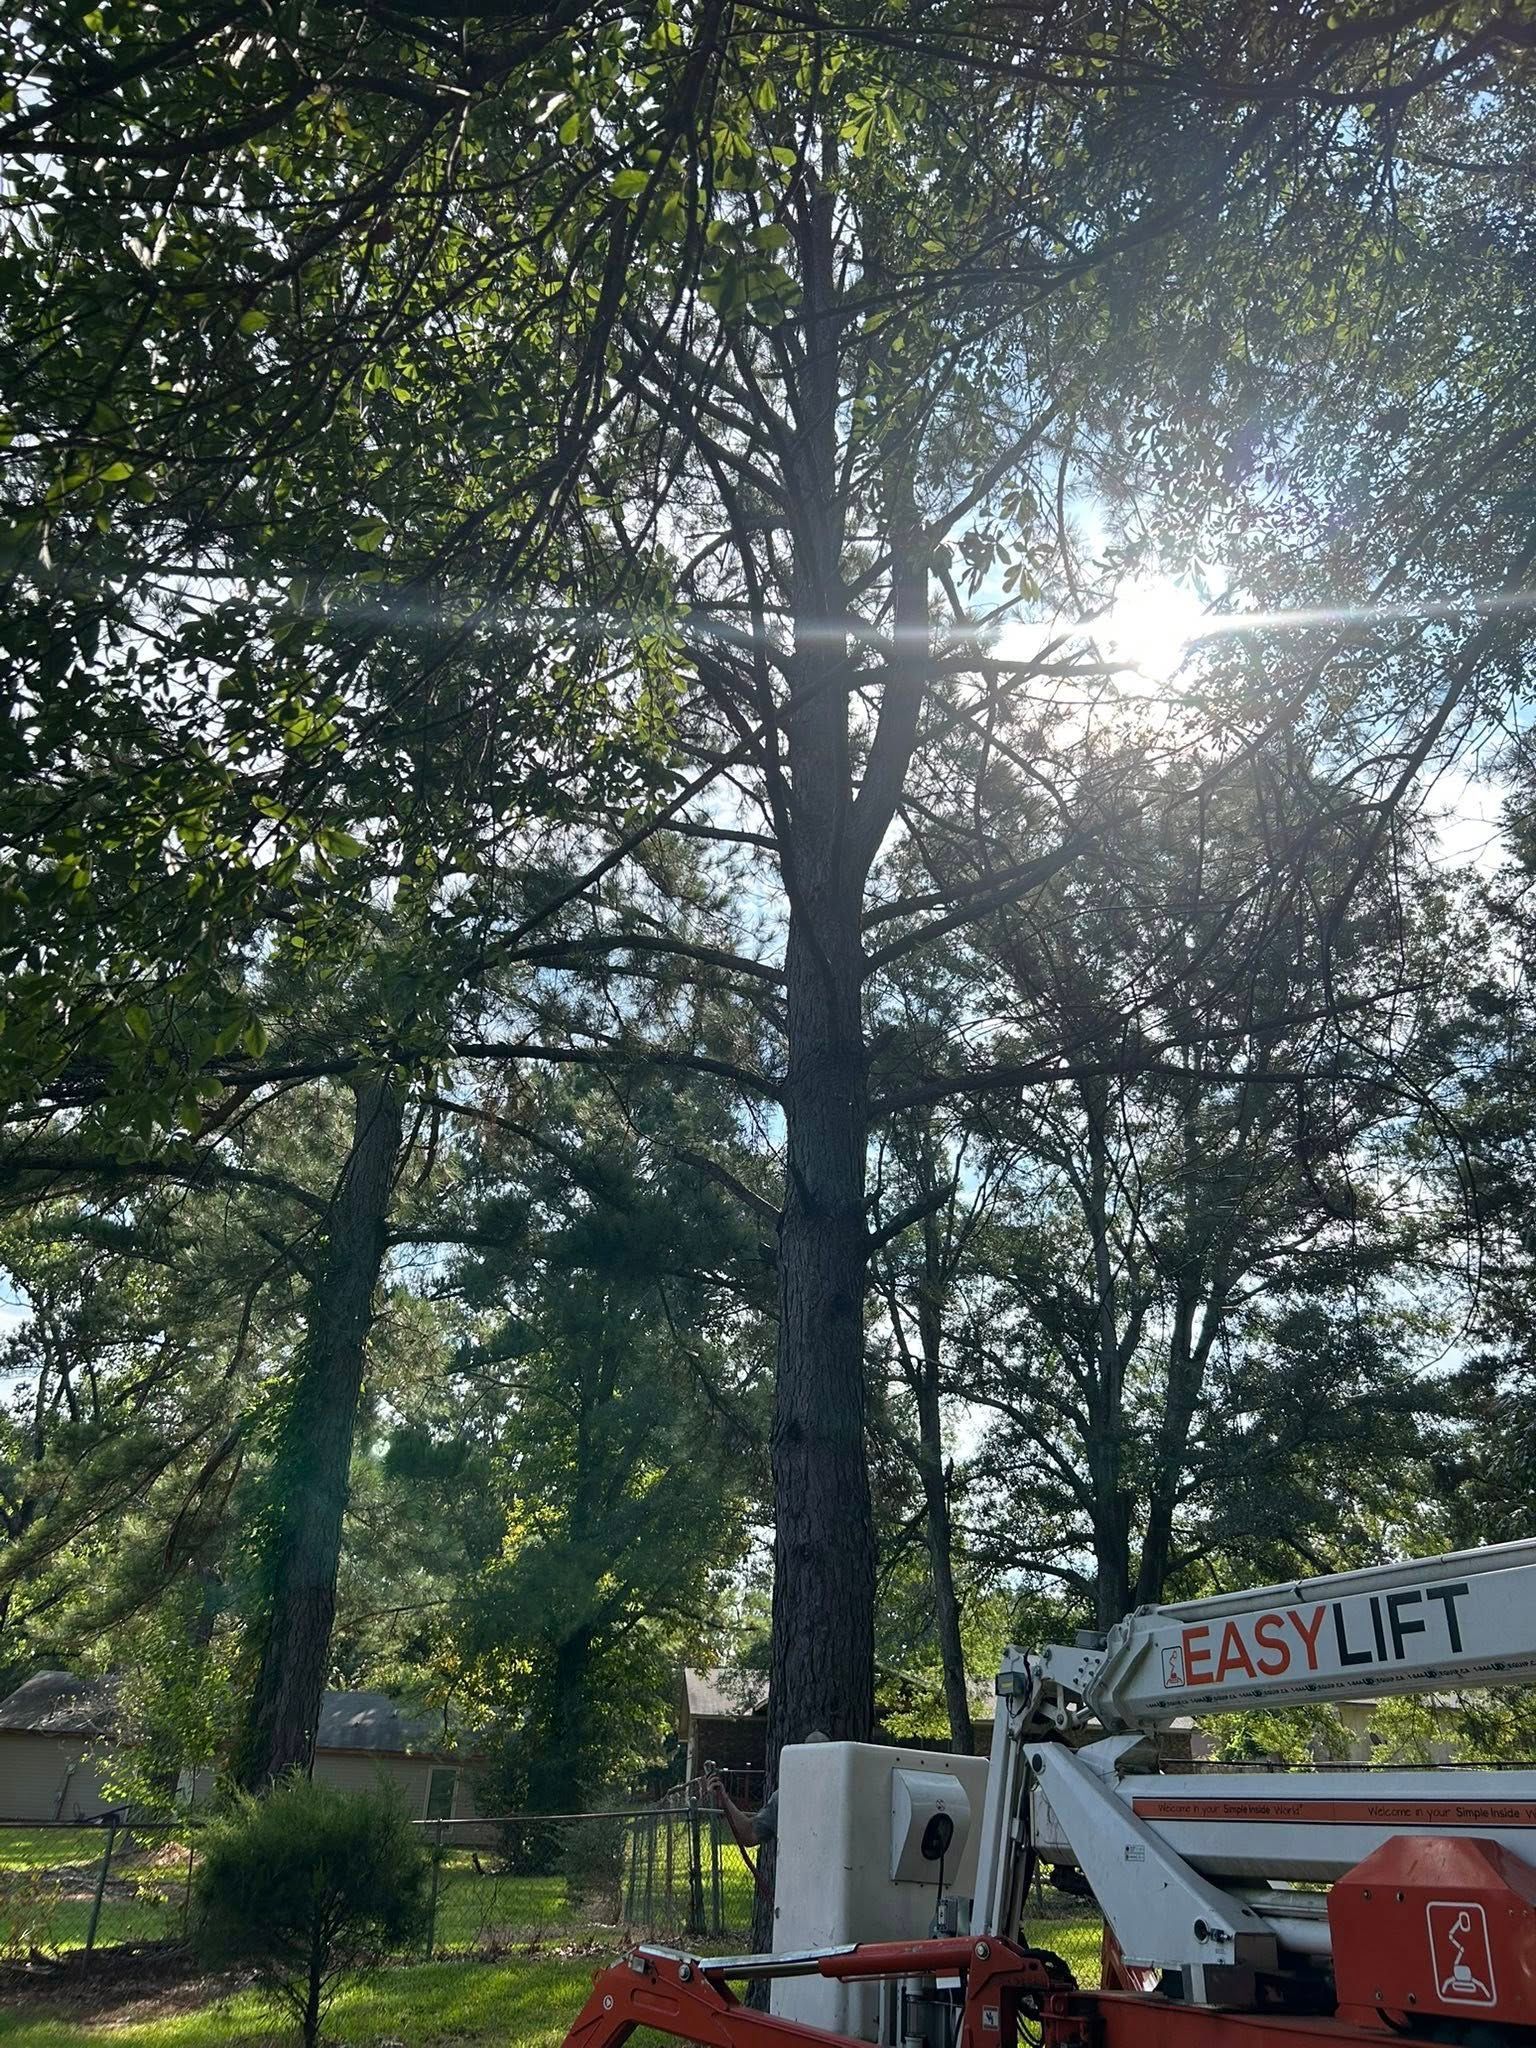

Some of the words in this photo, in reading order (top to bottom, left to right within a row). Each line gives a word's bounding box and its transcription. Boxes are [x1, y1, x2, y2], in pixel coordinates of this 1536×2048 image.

[1158, 1803, 1191, 1813] Welcome
[1202, 1805, 1219, 1817] your
[1368, 1805, 1411, 1817] Welcome
[1415, 1807, 1424, 1817] in
[1426, 1808, 1450, 1822] your
